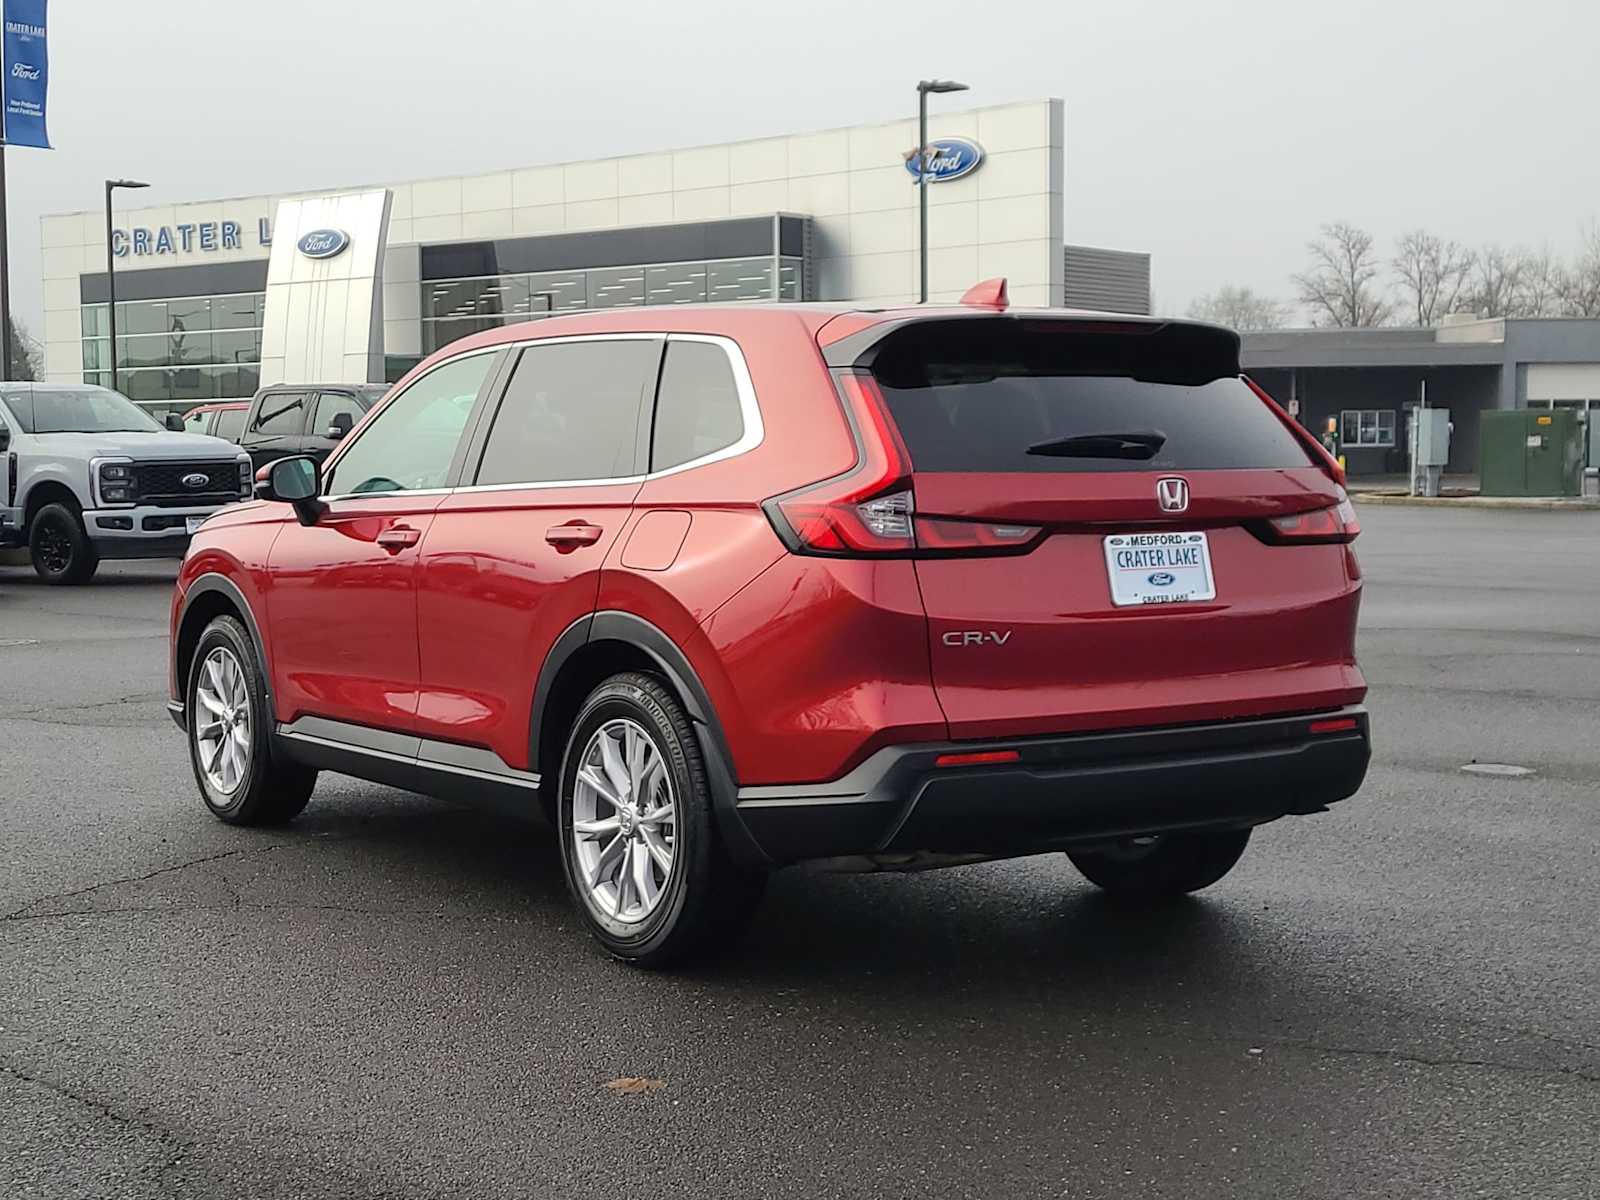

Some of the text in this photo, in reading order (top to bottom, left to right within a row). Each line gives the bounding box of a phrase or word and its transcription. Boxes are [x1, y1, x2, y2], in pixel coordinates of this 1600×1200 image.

[11, 62, 41, 80] Ford
[111, 221, 241, 257] CRATER
[304, 233, 333, 250] Ford
[1130, 535, 1182, 546] MEDFORD
[1117, 548, 1199, 568] CRATER LAKE
[1142, 594, 1169, 603] CRATER
[942, 631, 1012, 646] CR-V
